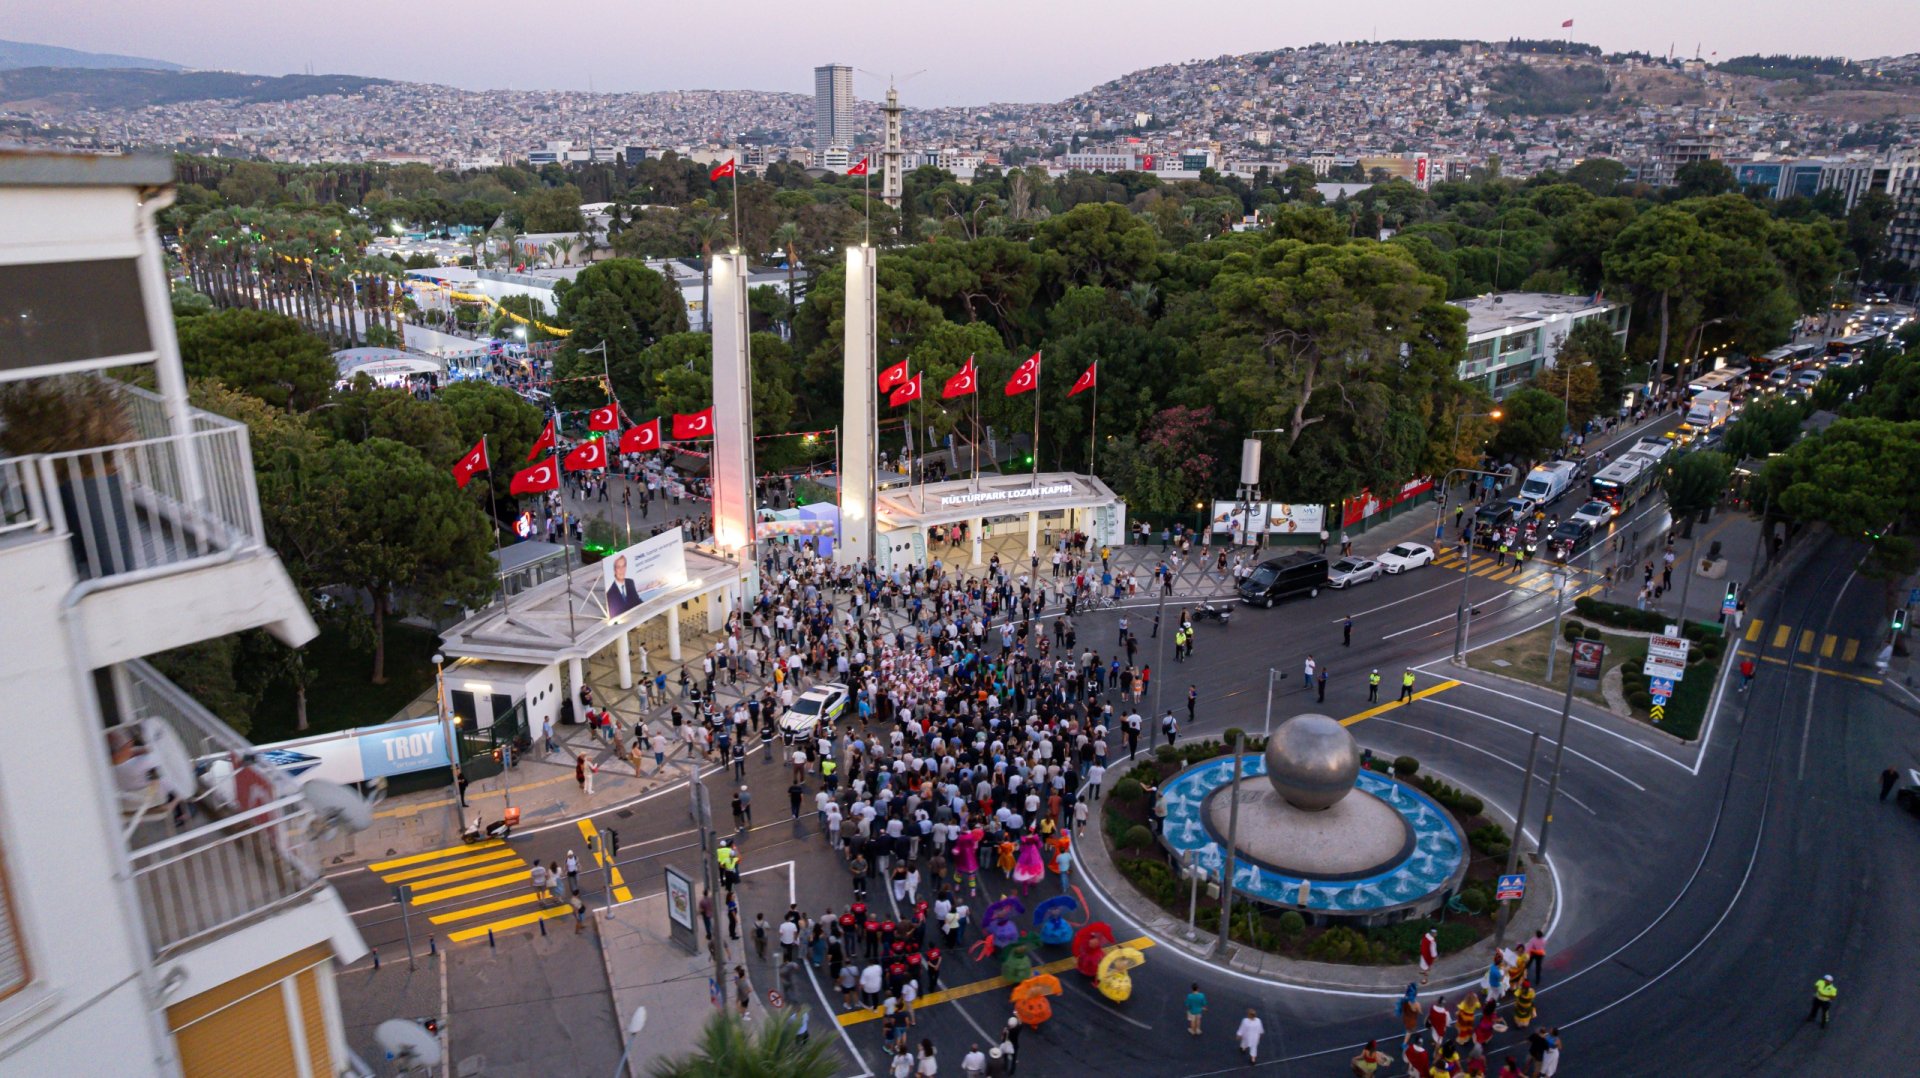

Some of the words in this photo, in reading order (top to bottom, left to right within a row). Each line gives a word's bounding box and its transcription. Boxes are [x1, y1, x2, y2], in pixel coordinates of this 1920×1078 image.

[941, 491, 1006, 505] KÜLTÜRPARK
[1008, 487, 1039, 499] LOZAN
[1040, 484, 1072, 496] KAPISI
[382, 732, 434, 761] TROY
